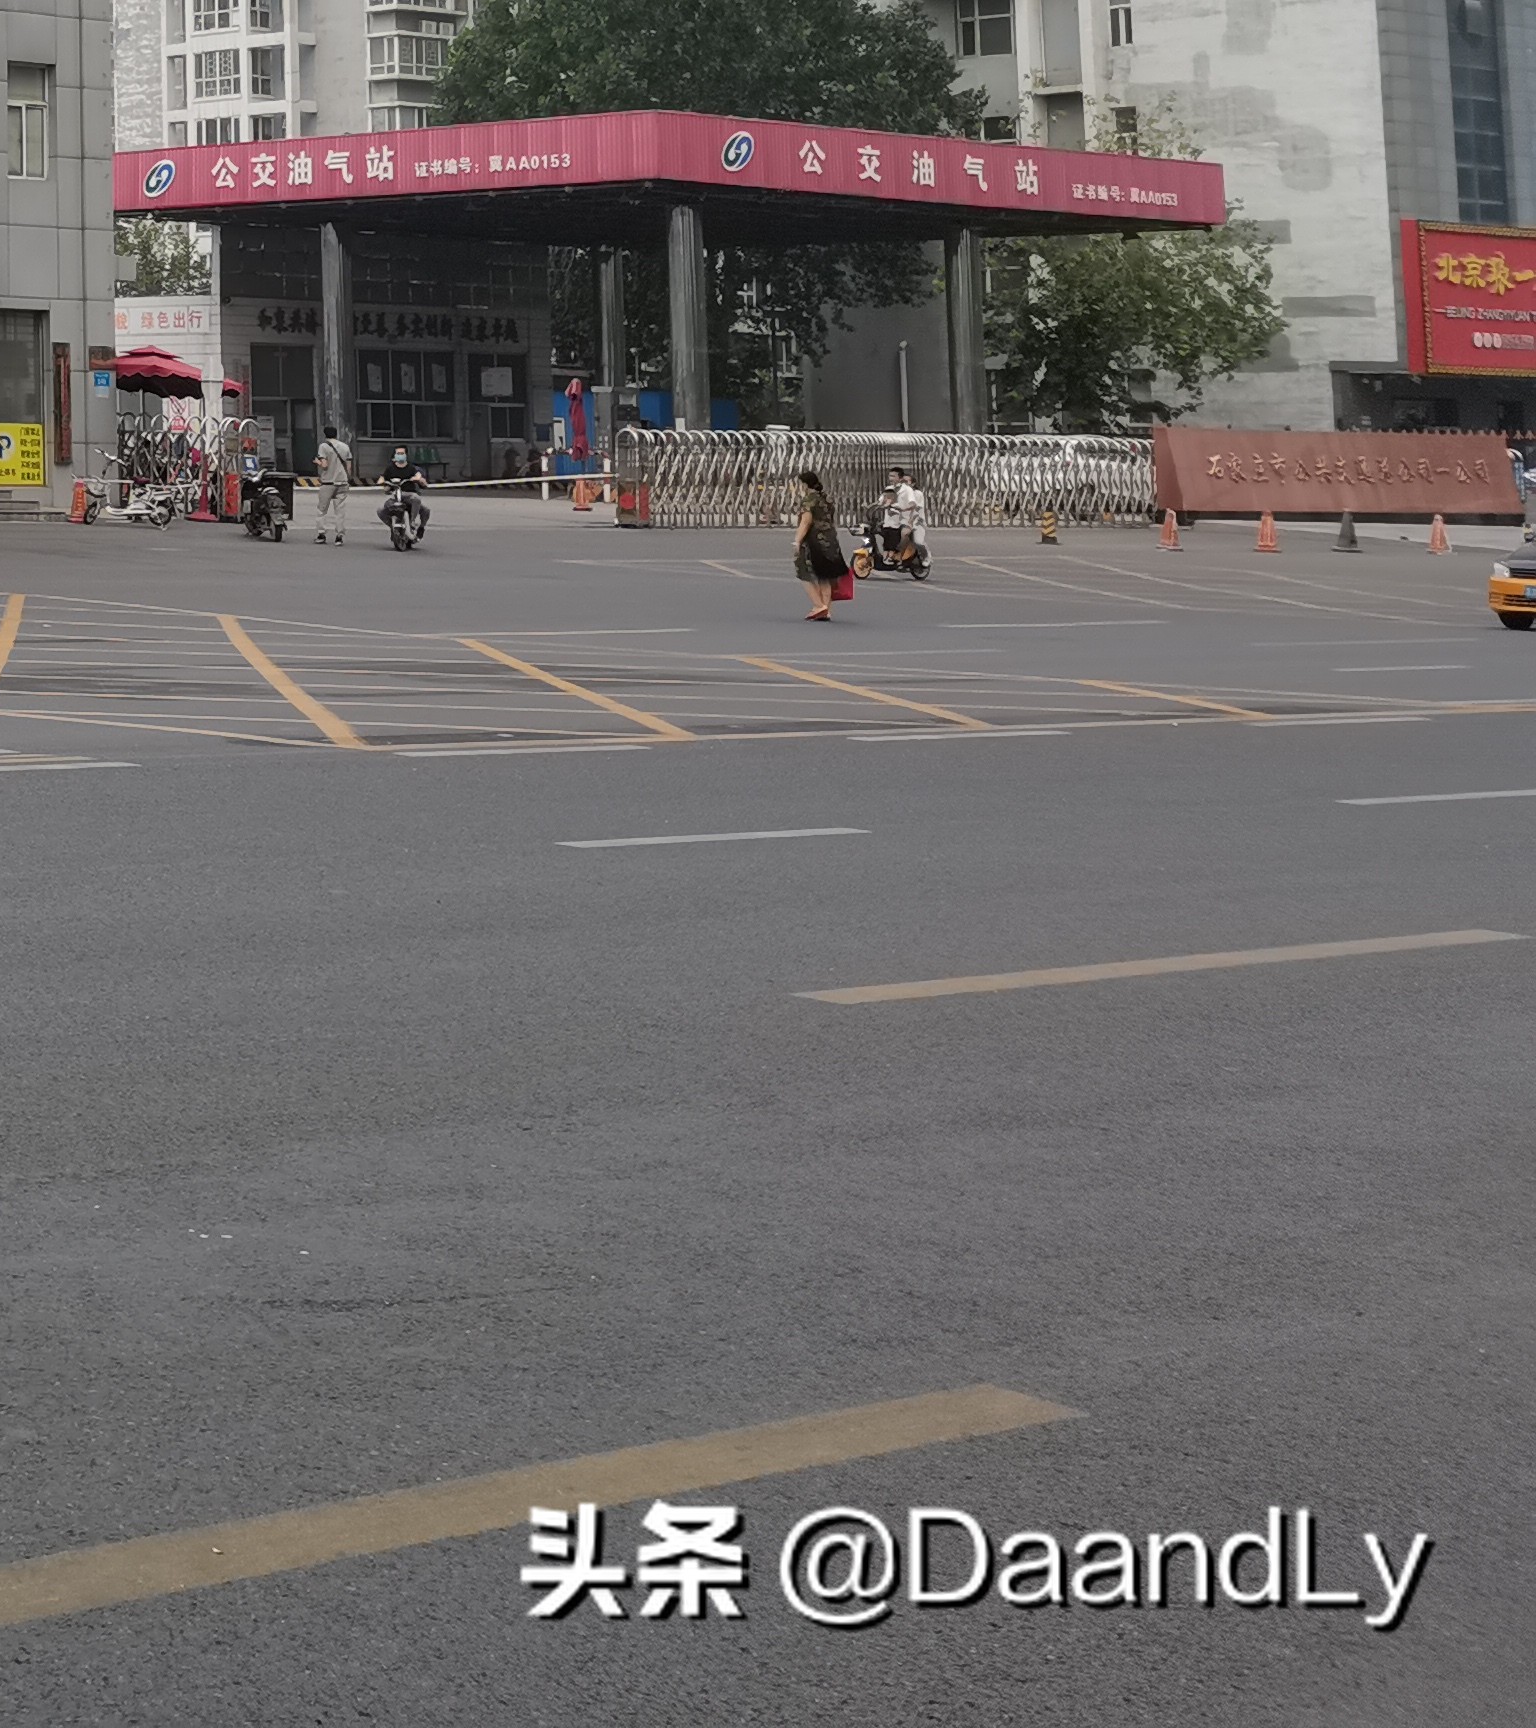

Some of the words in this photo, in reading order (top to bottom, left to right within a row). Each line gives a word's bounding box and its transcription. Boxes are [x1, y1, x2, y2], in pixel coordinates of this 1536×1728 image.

[211, 145, 395, 189] 公交油气站
[798, 139, 1040, 195] 公交油气站
[140, 310, 202, 330] 绿色出行
